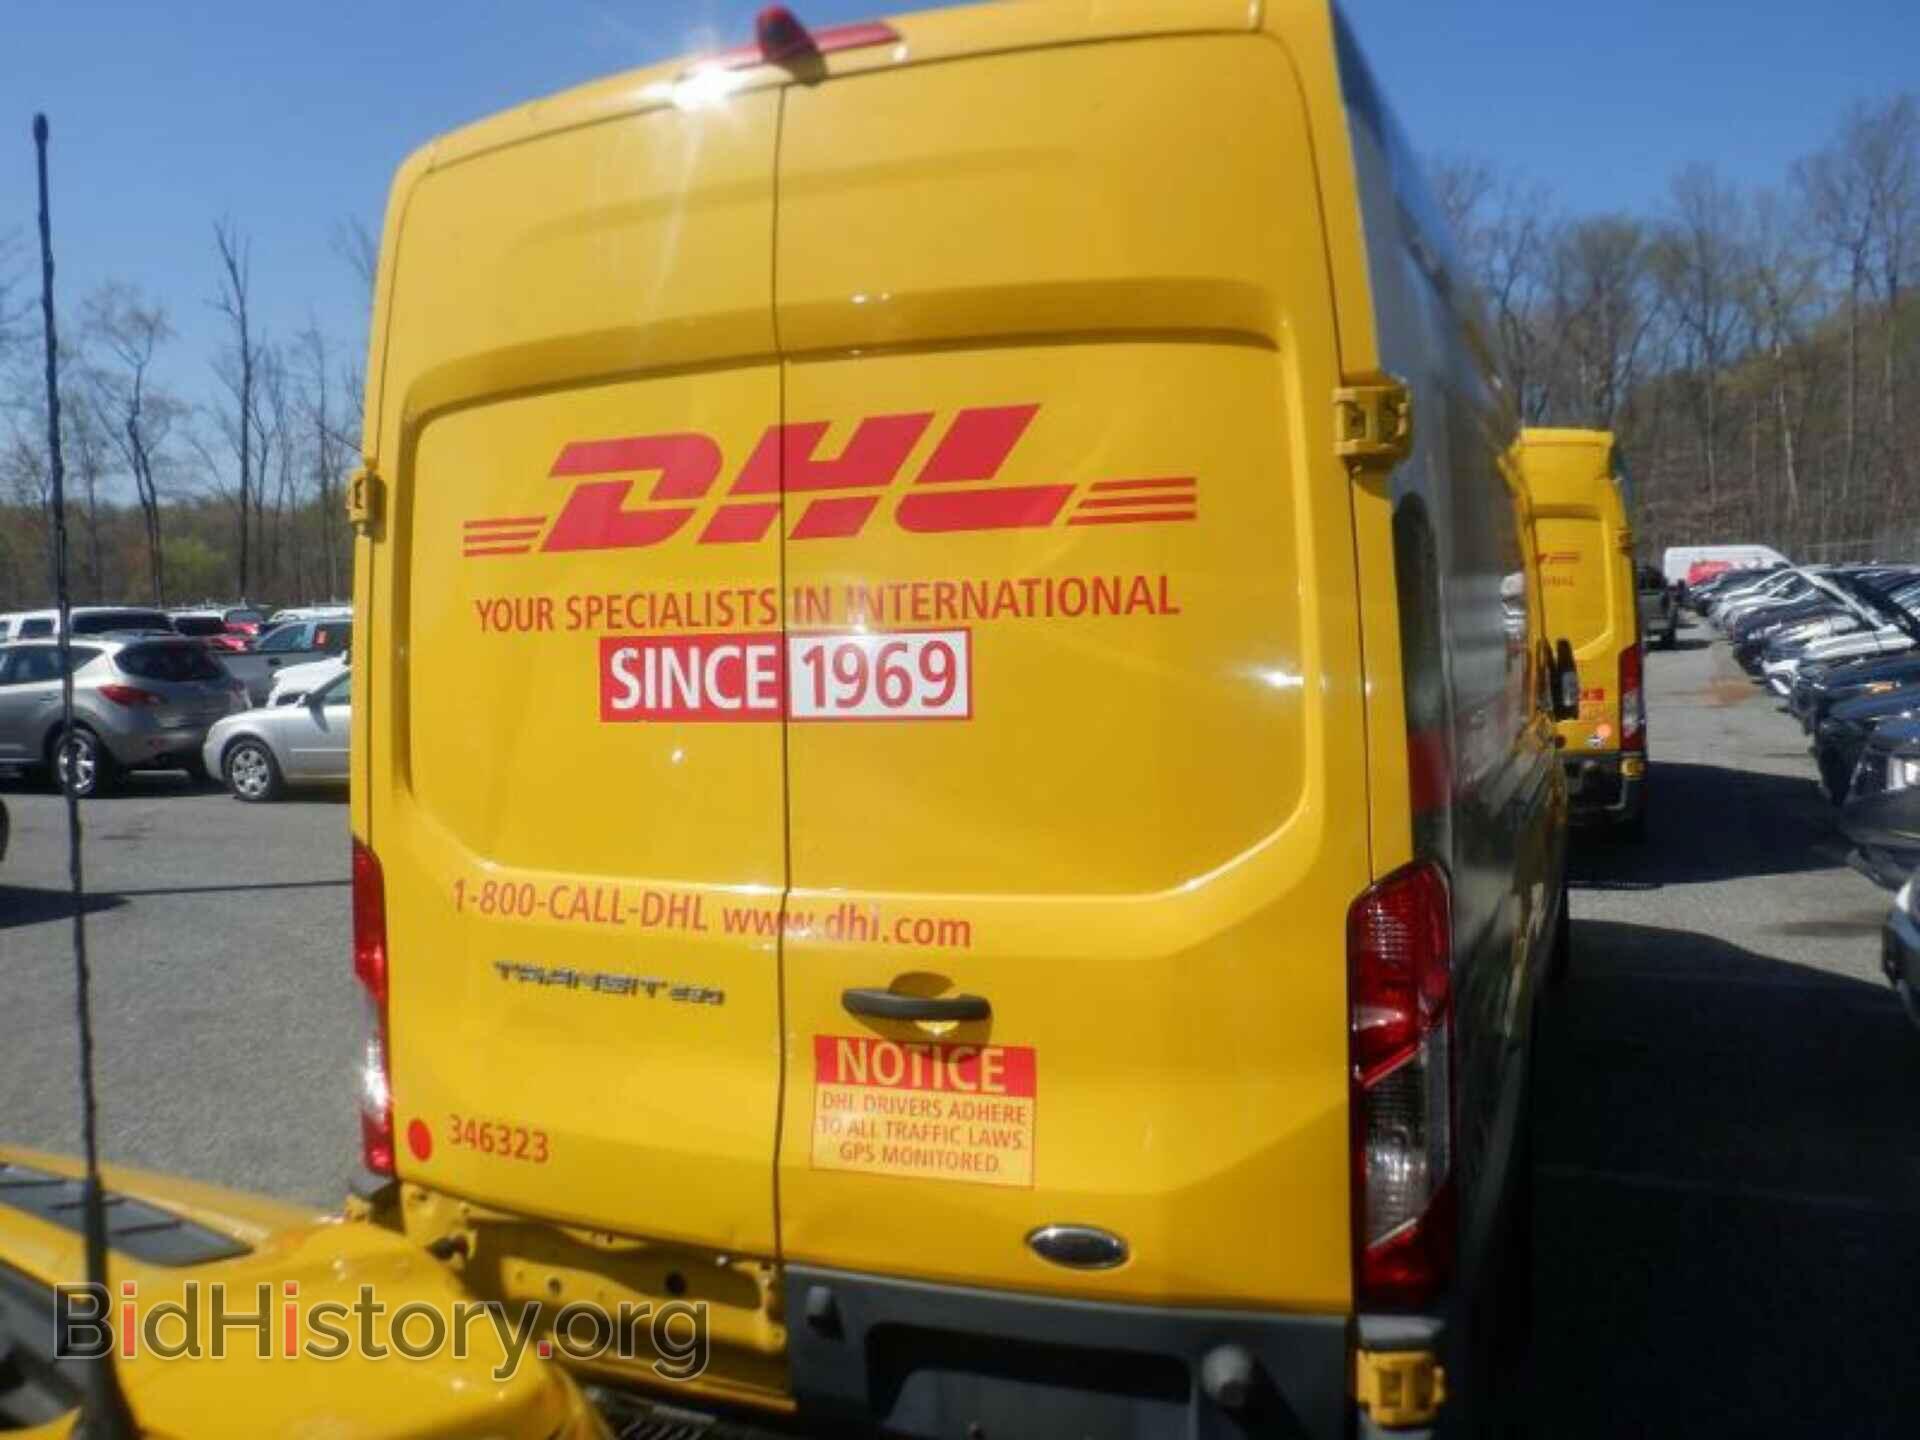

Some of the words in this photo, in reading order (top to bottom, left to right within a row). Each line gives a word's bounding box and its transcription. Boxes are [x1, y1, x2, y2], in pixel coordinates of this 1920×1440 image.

[540, 404, 1078, 553] DHL
[476, 596, 556, 632] YOUR
[565, 587, 778, 630] SPECIALISTS
[794, 584, 831, 625] IN
[846, 575, 1181, 624] INTERNATIONAL
[611, 644, 780, 710] SINCE
[801, 640, 957, 709] 1969
[453, 879, 709, 931] 1-800-CALL-DHL
[723, 902, 972, 948] wwwdhl.com
[836, 1039, 1007, 1093] NOTICE
[847, 1117, 877, 1139] ALL
[885, 1121, 962, 1147] TRAFFIC
[863, 1095, 943, 1119] DRIVERS
[948, 1101, 1027, 1126] ADHERE
[448, 1114, 549, 1164] 346323
[840, 1143, 876, 1164] GPS
